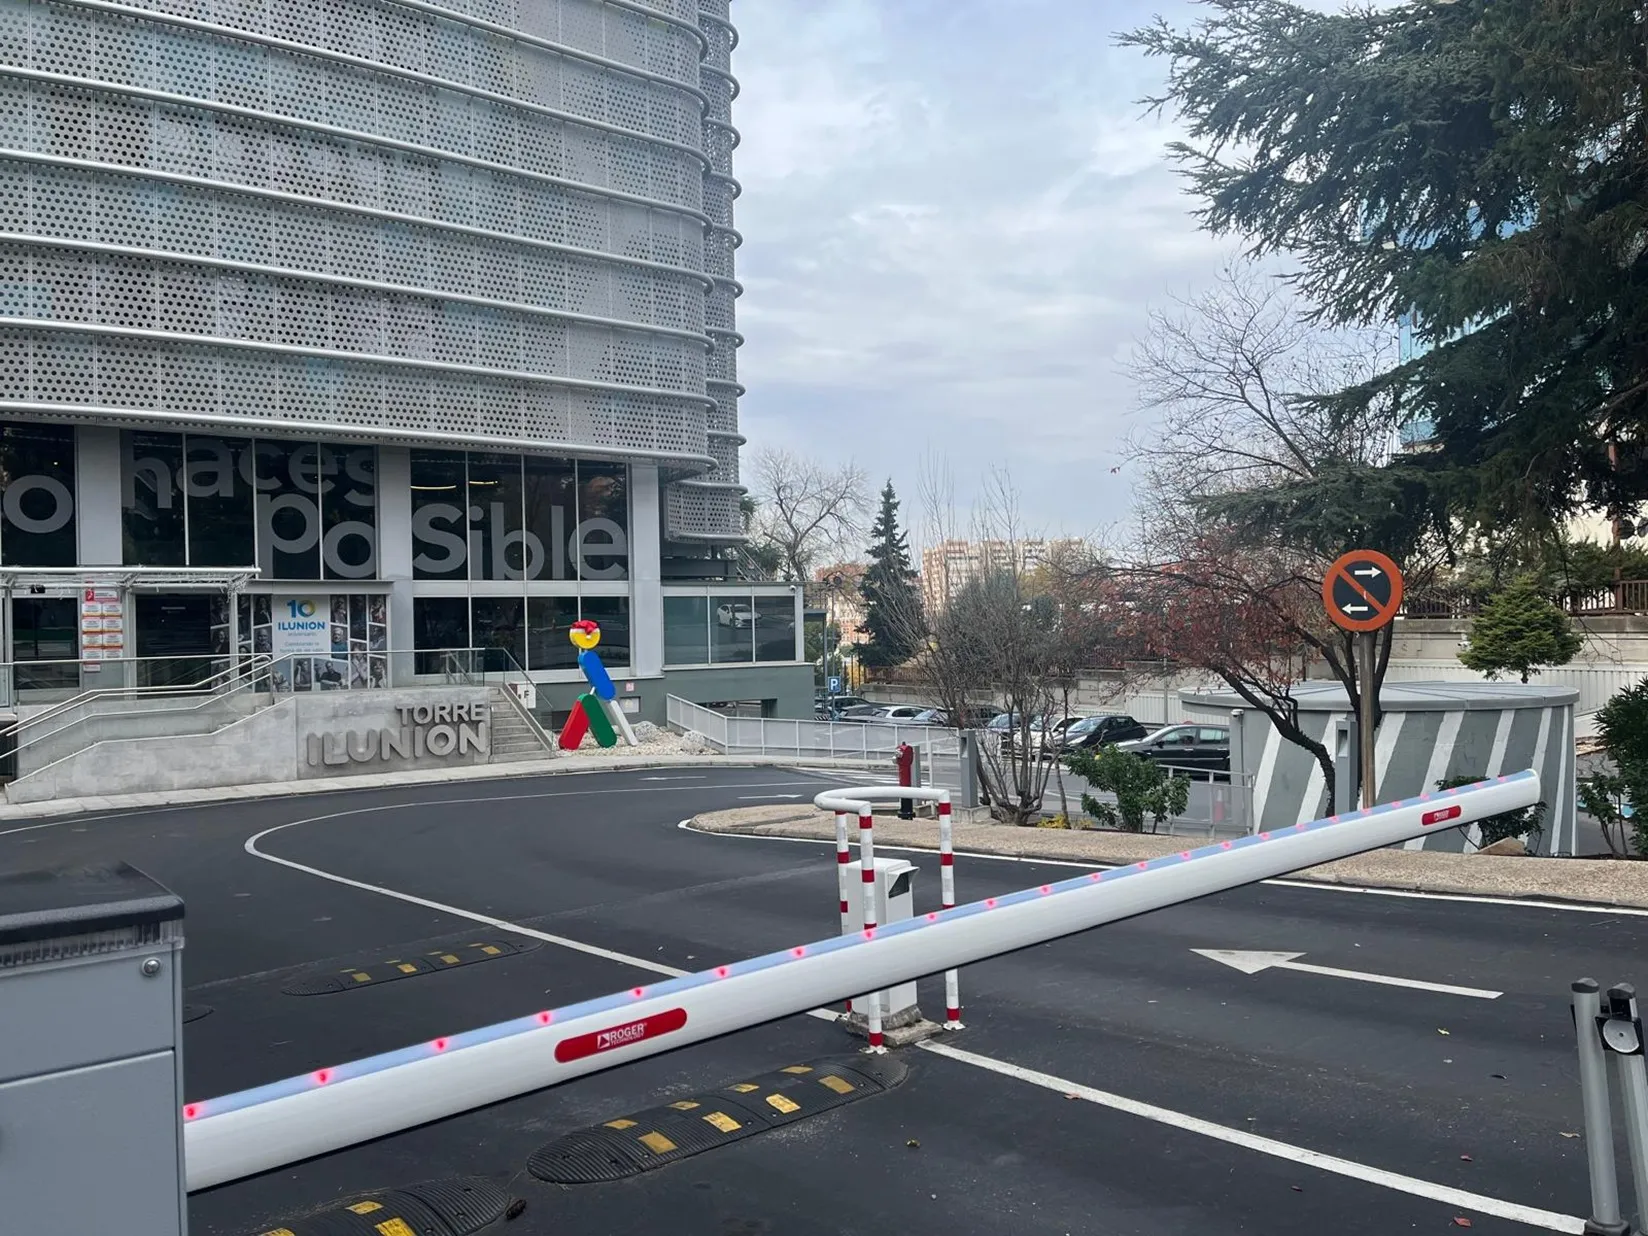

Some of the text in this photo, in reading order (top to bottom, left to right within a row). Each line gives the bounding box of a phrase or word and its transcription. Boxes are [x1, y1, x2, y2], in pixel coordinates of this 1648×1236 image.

[287, 600, 316, 618] 10
[278, 621, 326, 631] ILUNION
[831, 679, 838, 690] P
[395, 702, 486, 726] TORRE
[307, 722, 486, 766] ILUNION
[610, 1023, 645, 1041] ROGER
